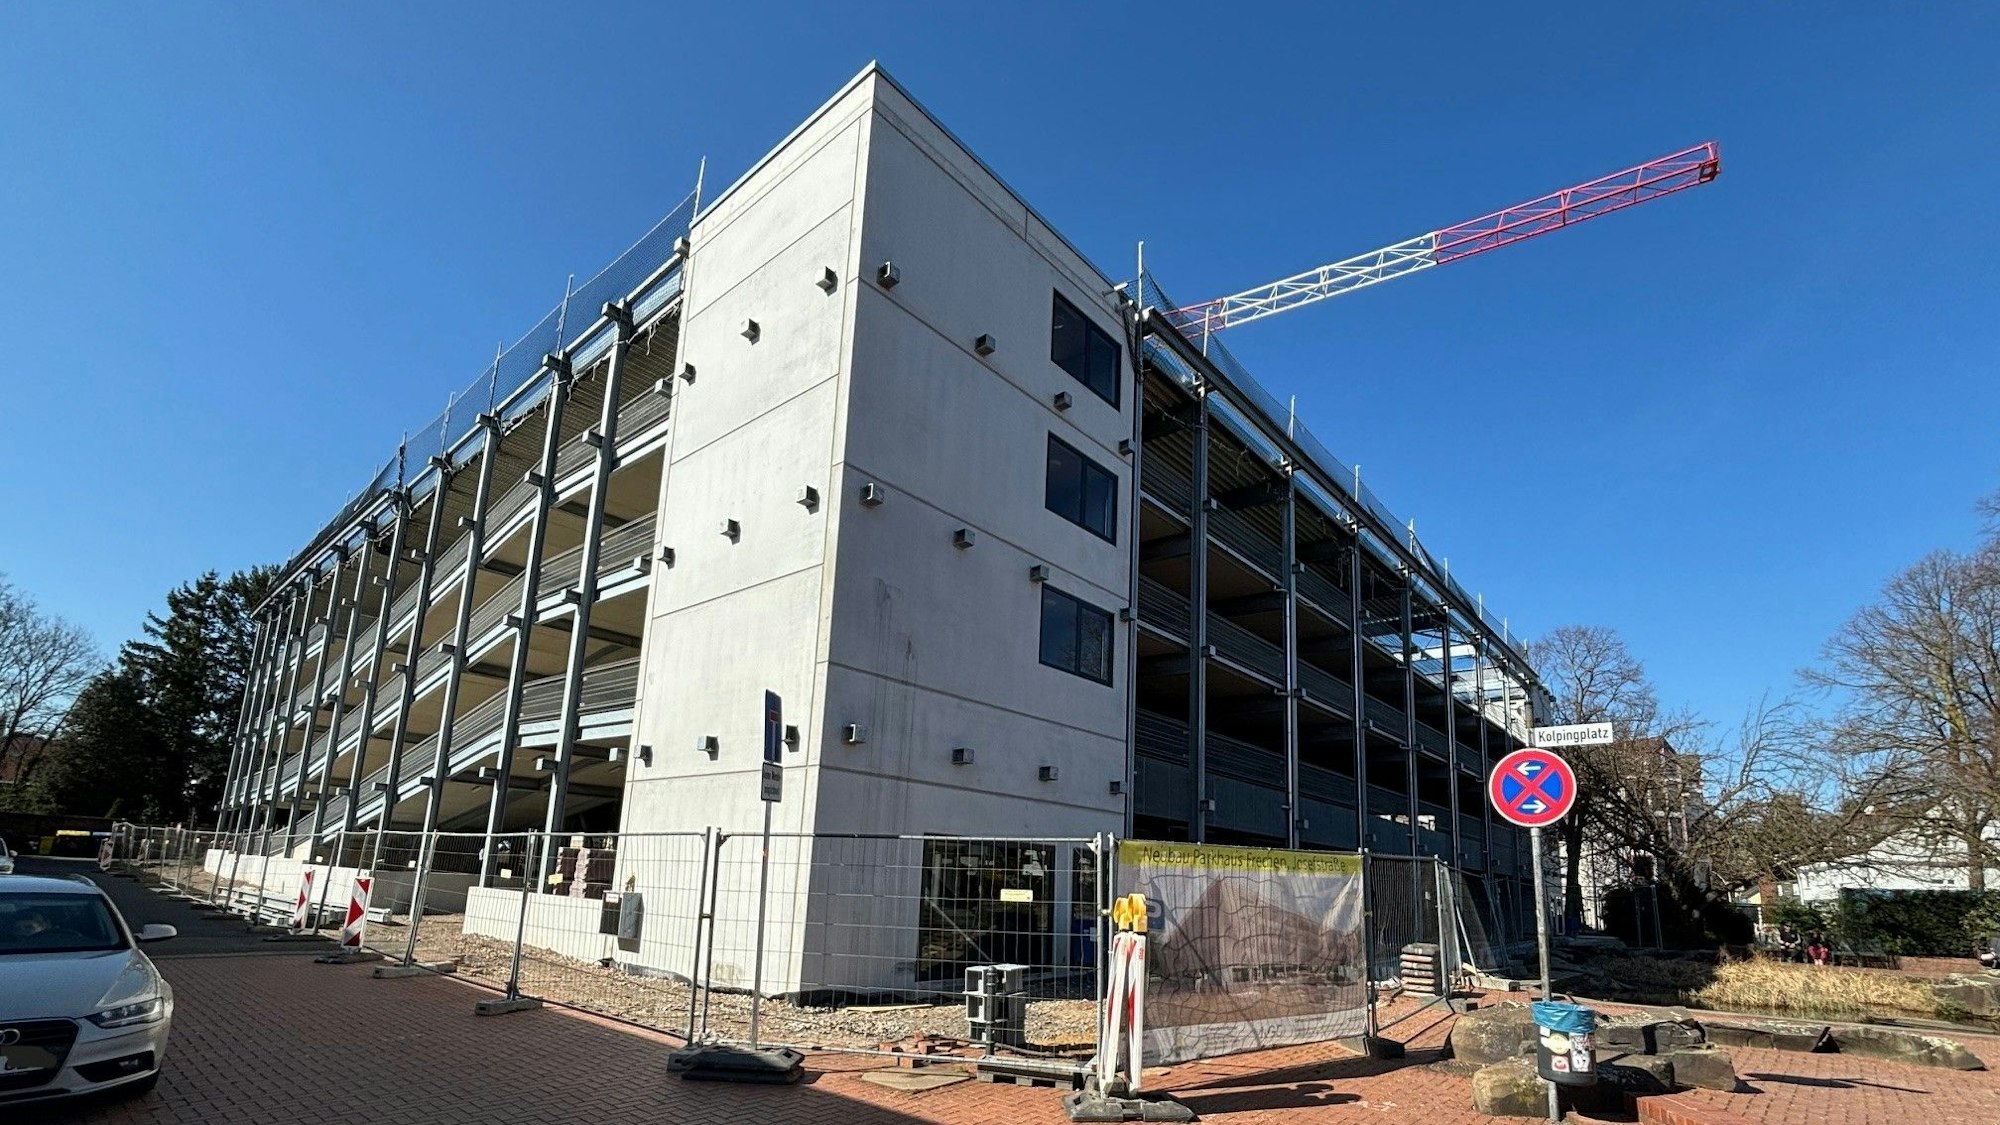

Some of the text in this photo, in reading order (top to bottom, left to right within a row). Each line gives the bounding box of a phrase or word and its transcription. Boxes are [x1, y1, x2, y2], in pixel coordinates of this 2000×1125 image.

[1539, 728, 1609, 743] Kolpingplatz
[1143, 846, 1190, 864] Neubau
[1193, 849, 1242, 867] Parkhaus
[1293, 856, 1346, 872] Josefstraße
